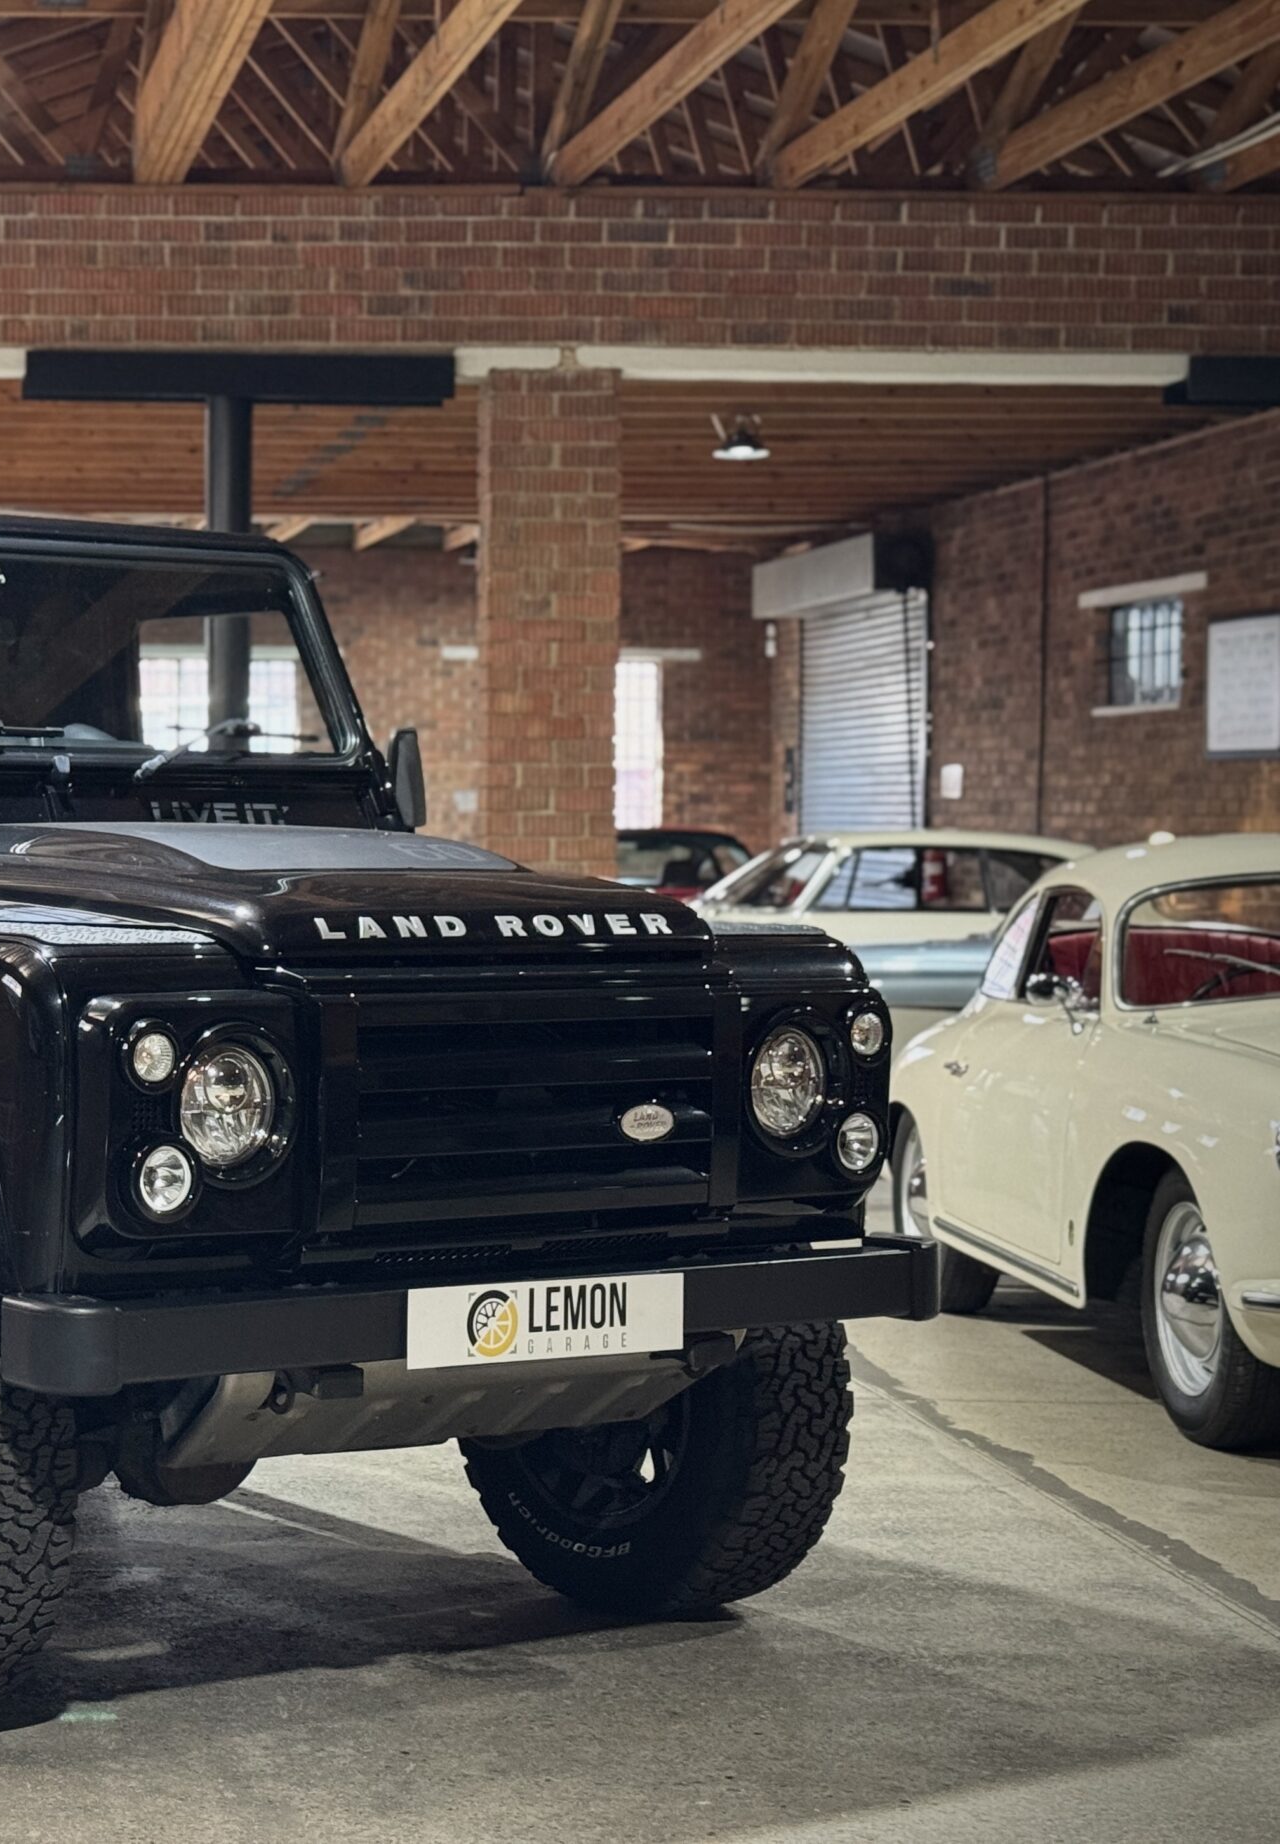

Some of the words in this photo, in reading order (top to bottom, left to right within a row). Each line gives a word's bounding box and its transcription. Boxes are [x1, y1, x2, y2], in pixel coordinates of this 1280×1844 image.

[313, 913, 467, 940] LAND
[493, 911, 673, 938] ROVER
[633, 1110, 660, 1122] LAND
[527, 1281, 628, 1333] LEMON
[527, 1331, 628, 1355] GARAGE
[506, 1491, 633, 1558] BFGoodrich
